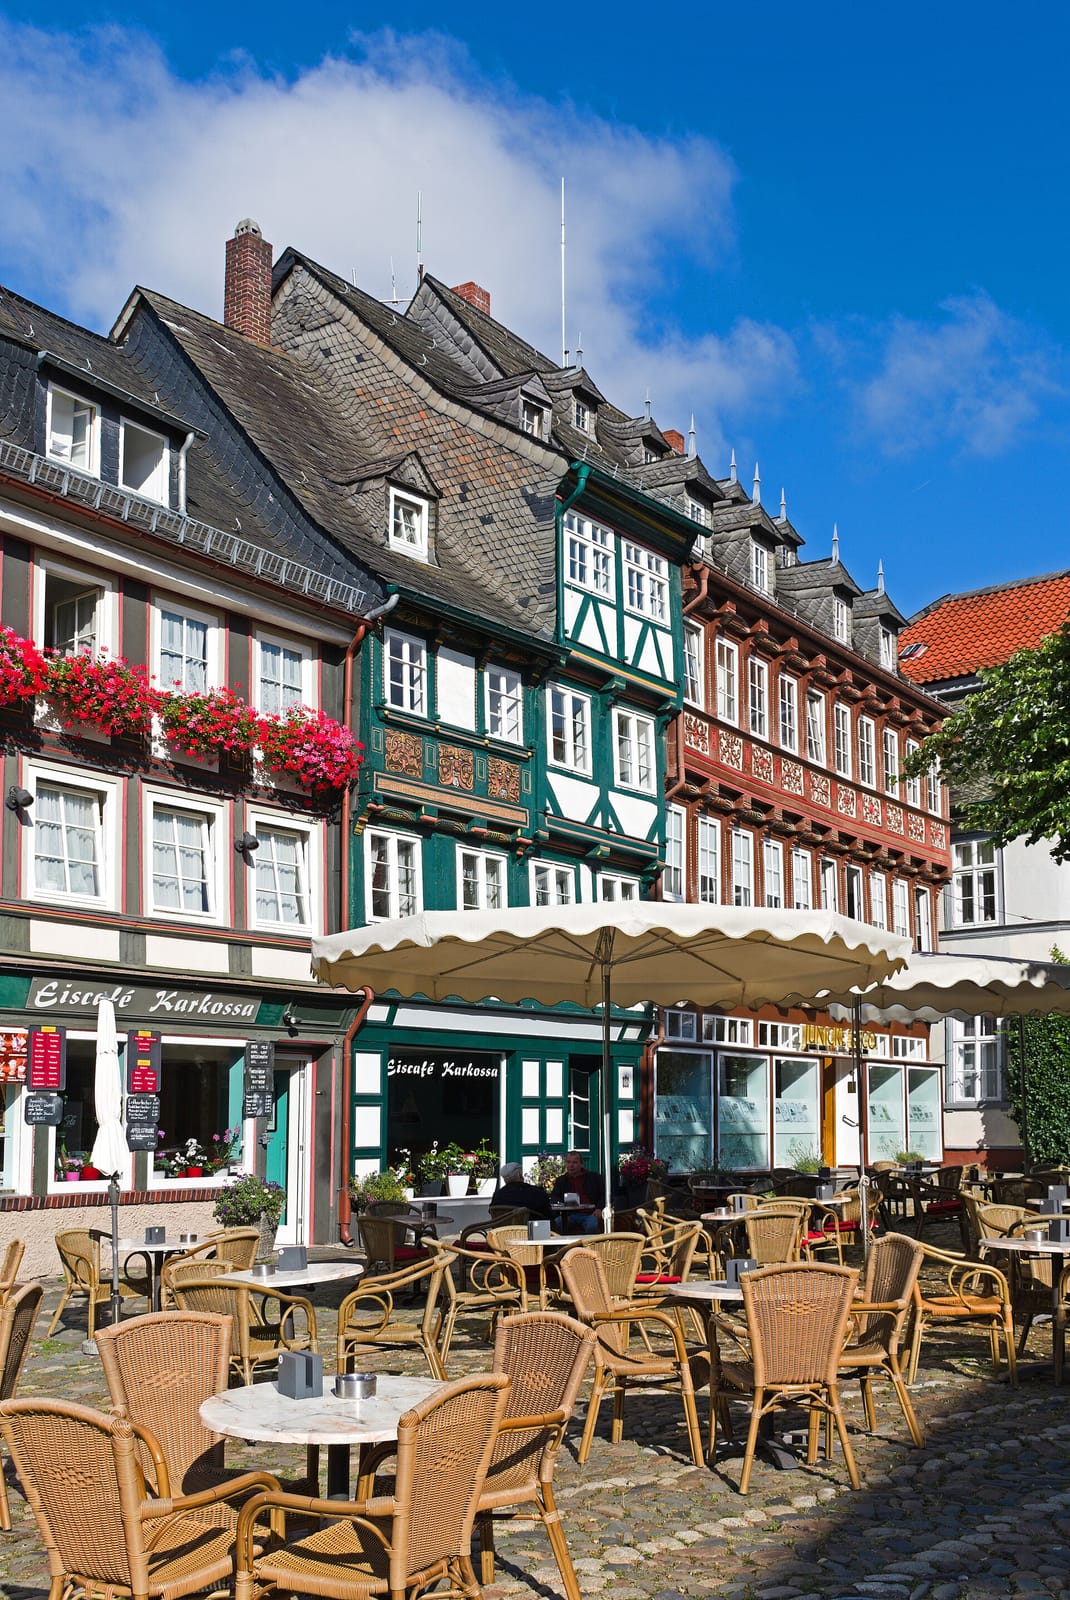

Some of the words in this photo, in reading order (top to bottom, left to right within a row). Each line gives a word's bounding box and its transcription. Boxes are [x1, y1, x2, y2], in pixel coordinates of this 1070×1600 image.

[148, 990, 255, 1017] Karkossa
[387, 1059, 435, 1078] Eiscafé
[441, 1062, 499, 1078] Karkossa
